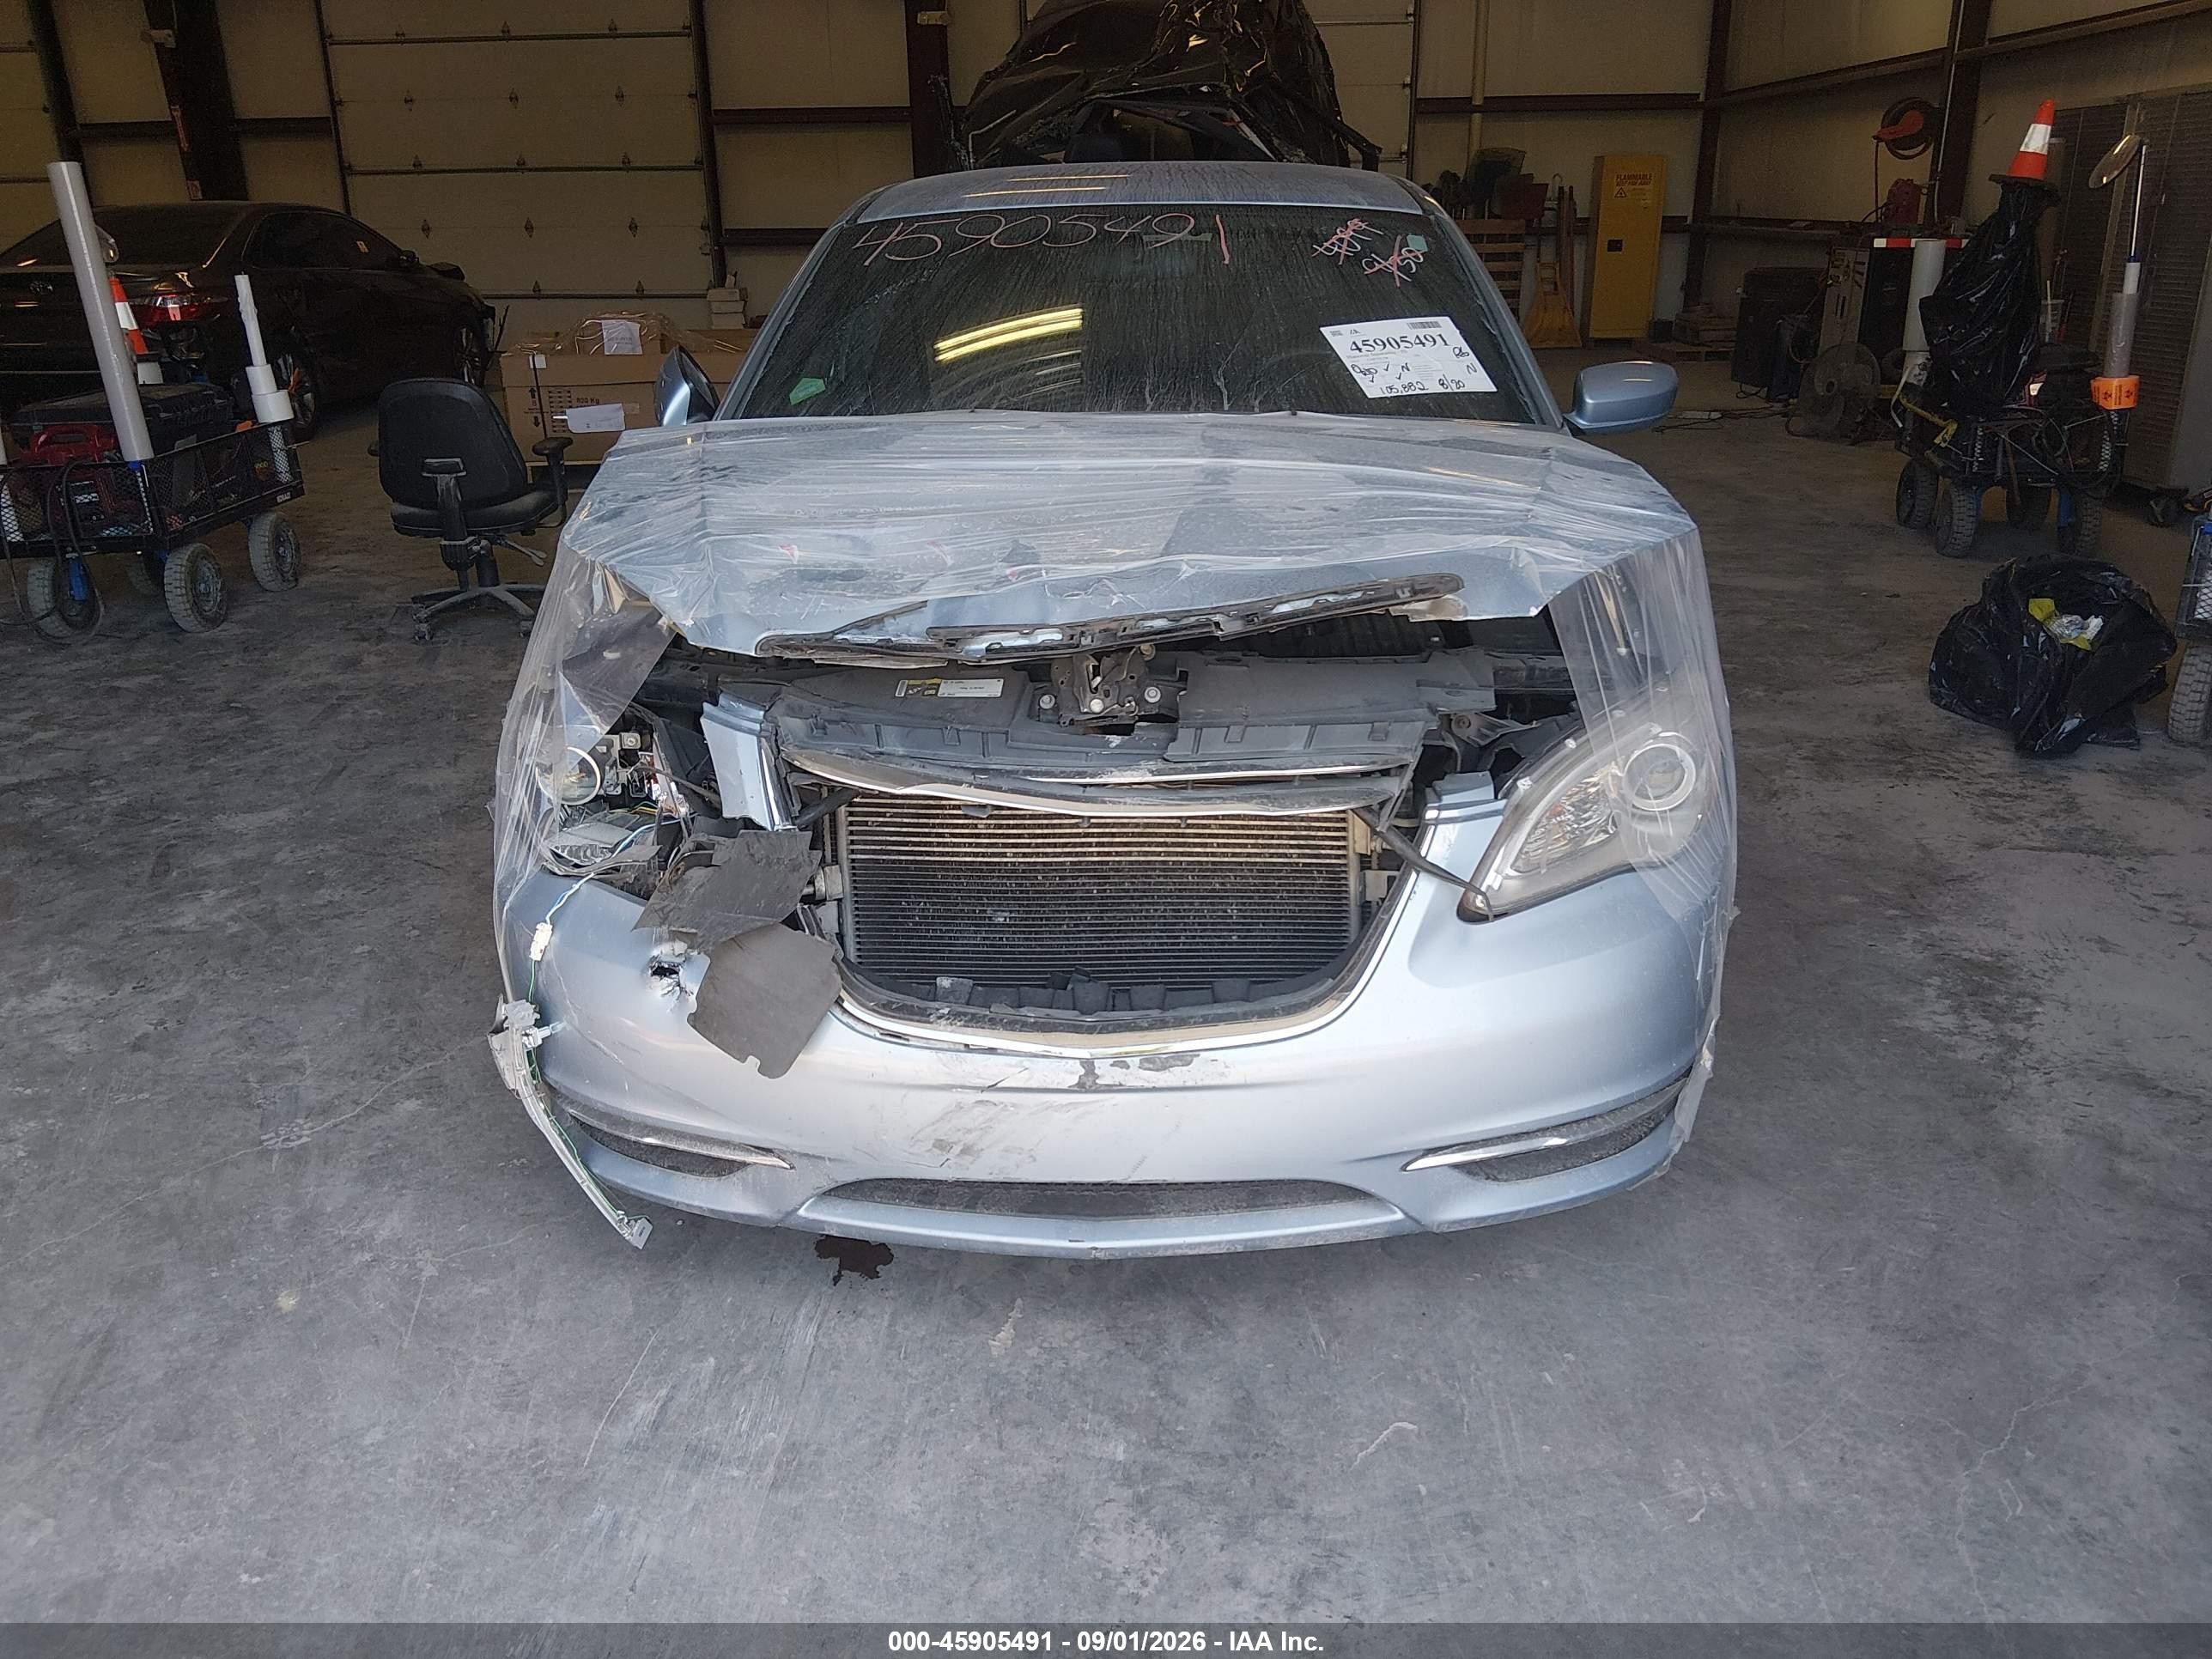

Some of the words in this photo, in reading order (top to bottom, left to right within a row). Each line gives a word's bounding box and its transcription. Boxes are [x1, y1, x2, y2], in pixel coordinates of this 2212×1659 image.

[1350, 333, 1451, 354] 45905491
[1380, 381, 1429, 395] 105,882
[1438, 374, 1466, 391] 8/20
